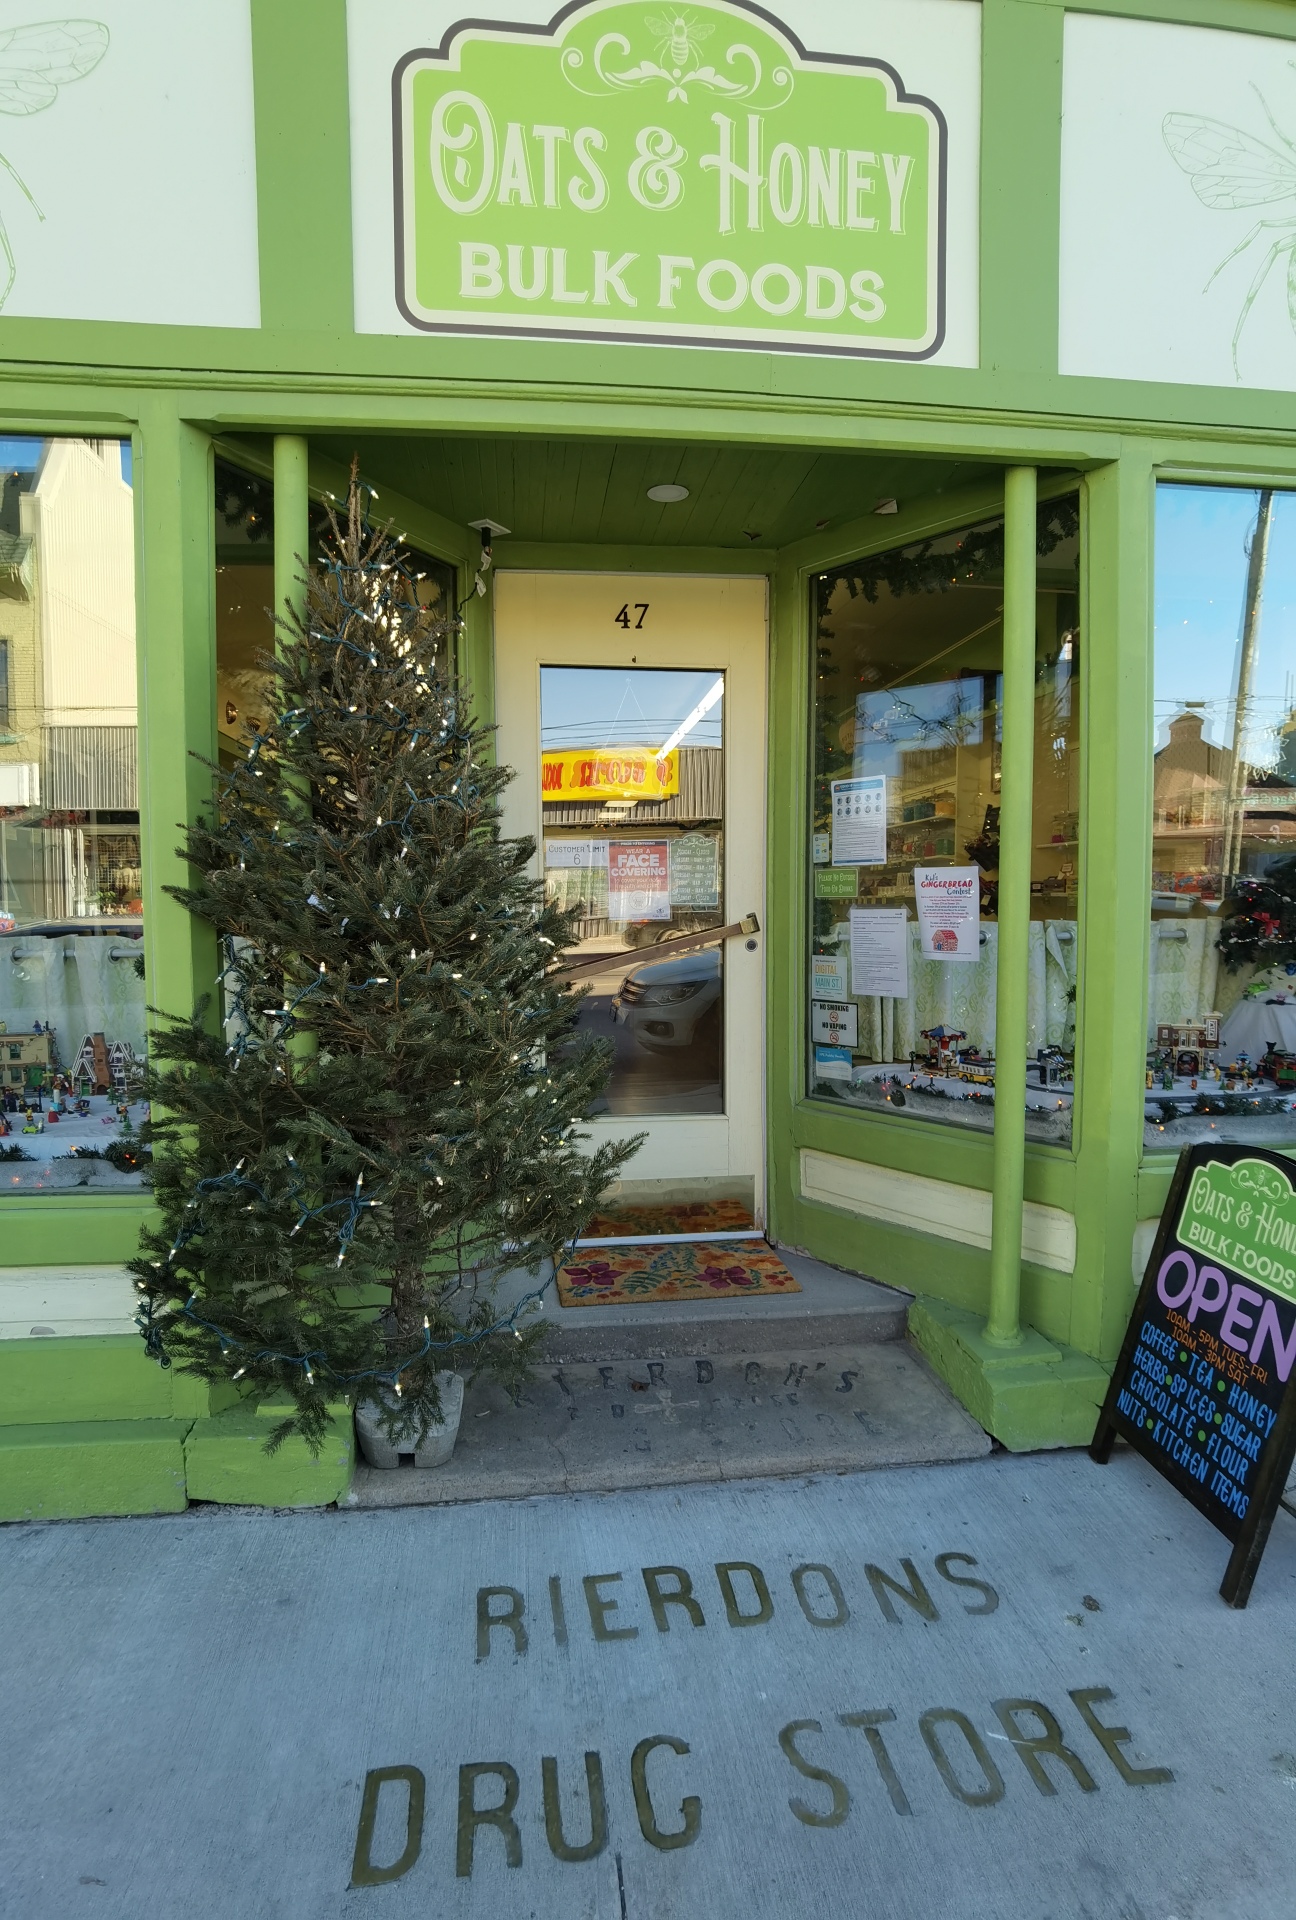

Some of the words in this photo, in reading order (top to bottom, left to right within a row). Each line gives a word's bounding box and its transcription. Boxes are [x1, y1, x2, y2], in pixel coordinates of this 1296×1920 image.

[430, 90, 609, 215] OATS
[627, 126, 688, 211] &
[700, 111, 915, 236] HONEY
[458, 241, 640, 308] BULK
[657, 254, 887, 324] FOODS
[614, 603, 650, 629] 47
[548, 844, 585, 853] CUSTOMER
[573, 853, 581, 866] 6
[617, 853, 660, 868] FACE
[610, 867, 667, 877] COVERING
[920, 879, 973, 889] GINGERBREAD
[815, 964, 837, 975] DIGITAL
[815, 977, 830, 987] MAIN
[819, 1003, 826, 1011] NO
[827, 1004, 849, 1012] SMOKING
[822, 1021, 828, 1029] NO
[829, 1022, 847, 1031] VAPING
[1192, 1177, 1235, 1224] OATS
[1236, 1201, 1254, 1229] &
[1188, 1221, 1233, 1258] BULK
[1231, 1243, 1296, 1290] FOODS
[1157, 1250, 1296, 1382] OPEN
[1166, 1308, 1192, 1333] 10AM
[1198, 1330, 1219, 1352] 5PM
[1171, 1326, 1198, 1354] 10AM
[1141, 1321, 1179, 1362] COFFEE
[1188, 1352, 1214, 1391] TEA
[1227, 1383, 1278, 1438] HONEY
[1133, 1345, 1168, 1386] HERBS
[1170, 1374, 1216, 1423] SPICES
[1220, 1413, 1262, 1463] SUGAR
[1130, 1370, 1197, 1438] CHOCOLATE
[1206, 1433, 1249, 1486] FLOUR
[1117, 1388, 1147, 1428] NUTS
[1152, 1418, 1210, 1484] KITCHEN
[1210, 1469, 1250, 1520] ITEMS
[474, 1551, 1001, 1665] RIERDONS
[347, 1733, 702, 1891] DRUG
[777, 1686, 1176, 1830] STORE
